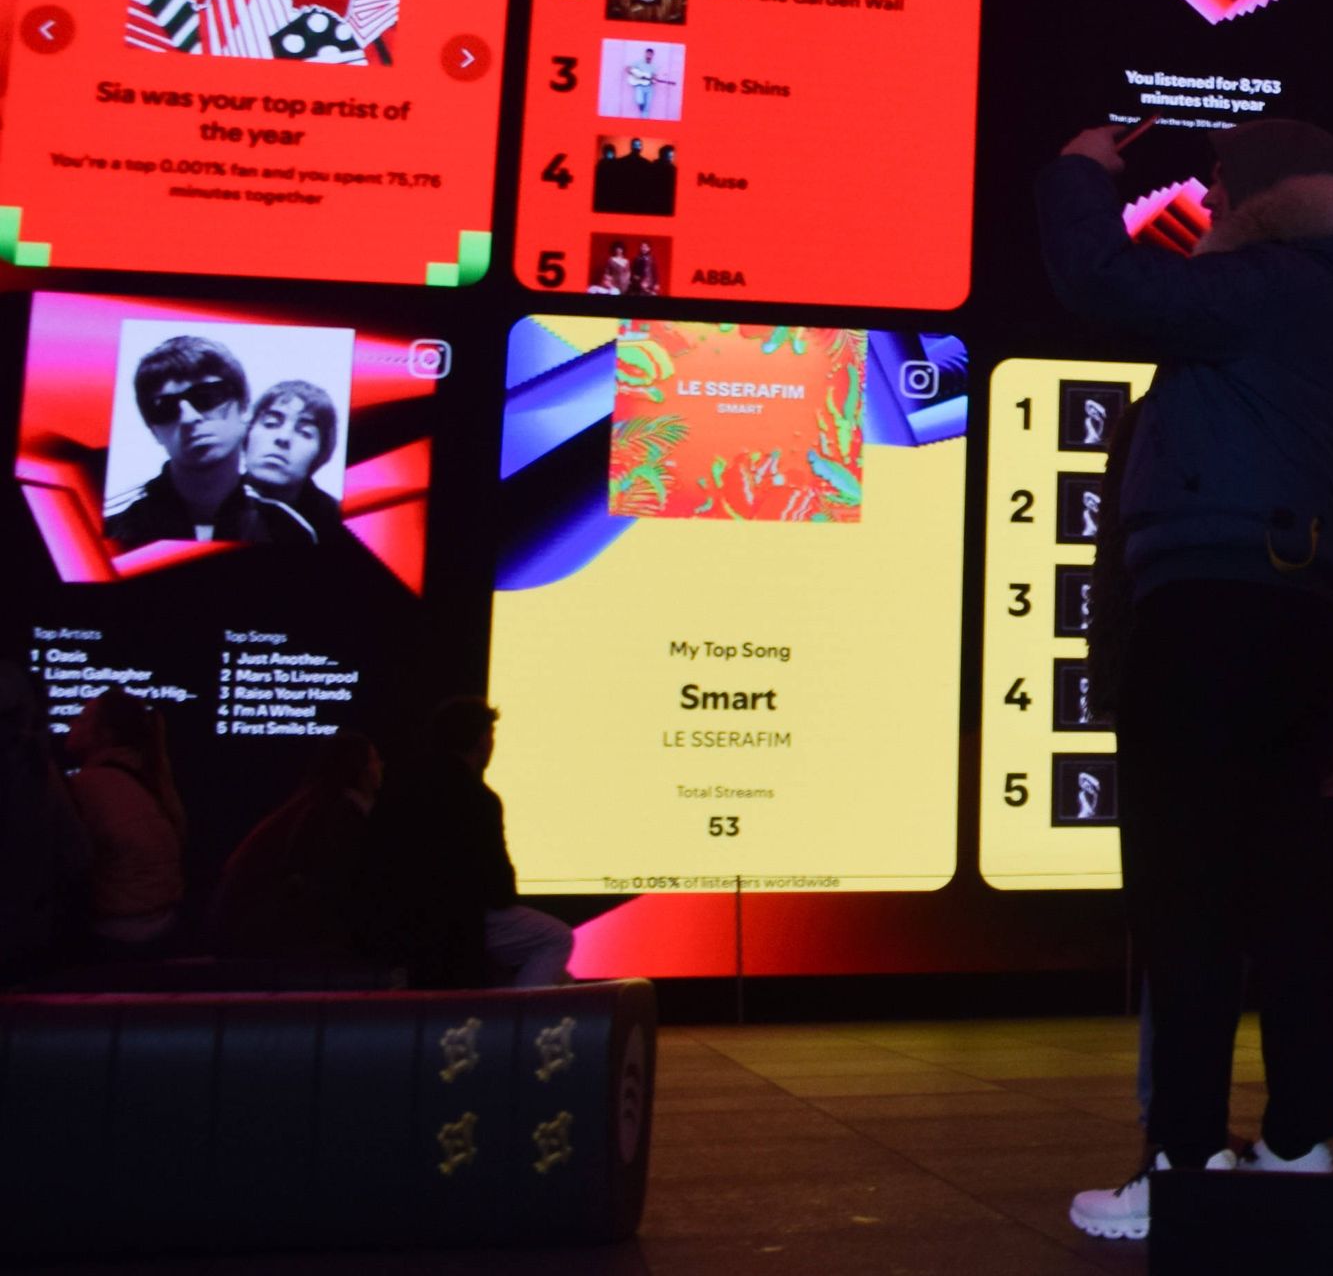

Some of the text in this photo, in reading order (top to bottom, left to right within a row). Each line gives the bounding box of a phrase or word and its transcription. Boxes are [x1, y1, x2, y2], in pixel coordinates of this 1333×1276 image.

[702, 75, 791, 98] The Shins
[1124, 69, 1282, 95] You listened for 8,763
[95, 80, 411, 121] Sia was your top artist of
[1139, 89, 1266, 113] minutes this year
[198, 120, 305, 148] the year
[696, 171, 749, 191] Muse
[690, 268, 746, 287] ABBA
[676, 379, 805, 399] LE SSERAFIM
[716, 402, 764, 414] SMART
[1015, 396, 1032, 431] 1
[1009, 488, 1035, 523] 2
[1007, 582, 1032, 618] 3
[669, 640, 791, 663] My Top Song
[235, 668, 359, 686] Mars To Liverpool
[680, 683, 777, 711] Smart
[1003, 677, 1032, 712] 4
[231, 720, 339, 736] First Smile Ever
[662, 729, 792, 748] LE SSERAFIM
[675, 784, 775, 799] Total Streams
[1003, 772, 1029, 808] 5
[708, 815, 740, 837] 53
